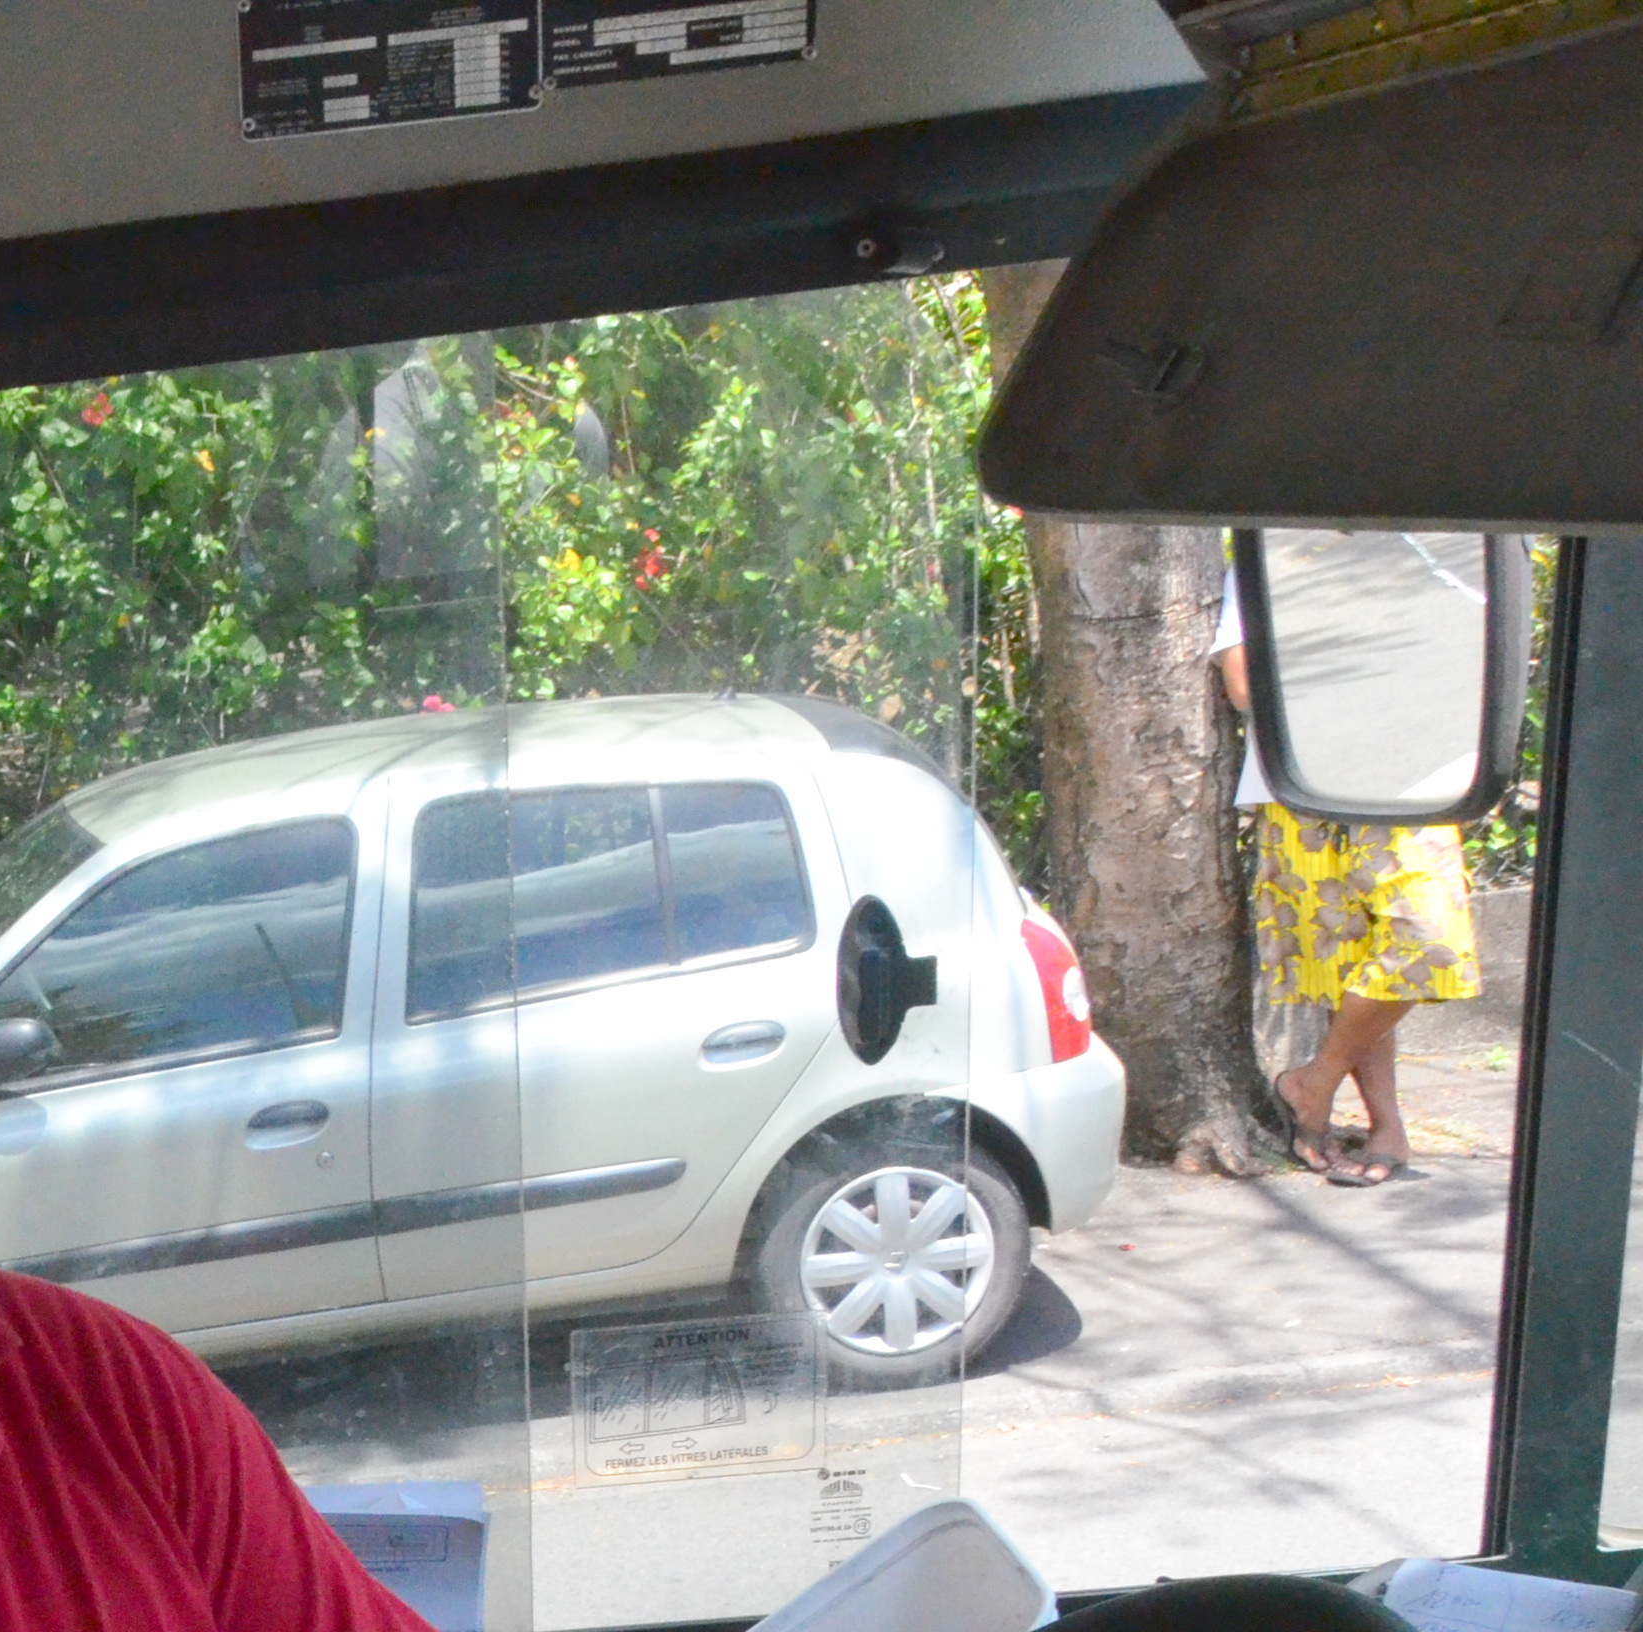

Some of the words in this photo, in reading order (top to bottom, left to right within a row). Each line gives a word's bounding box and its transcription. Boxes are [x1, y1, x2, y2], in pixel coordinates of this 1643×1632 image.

[653, 1327, 751, 1349] ATTENTION
[604, 1456, 646, 1470] FERMEZ
[649, 1454, 669, 1467] LES
[671, 1450, 708, 1464] VITRES
